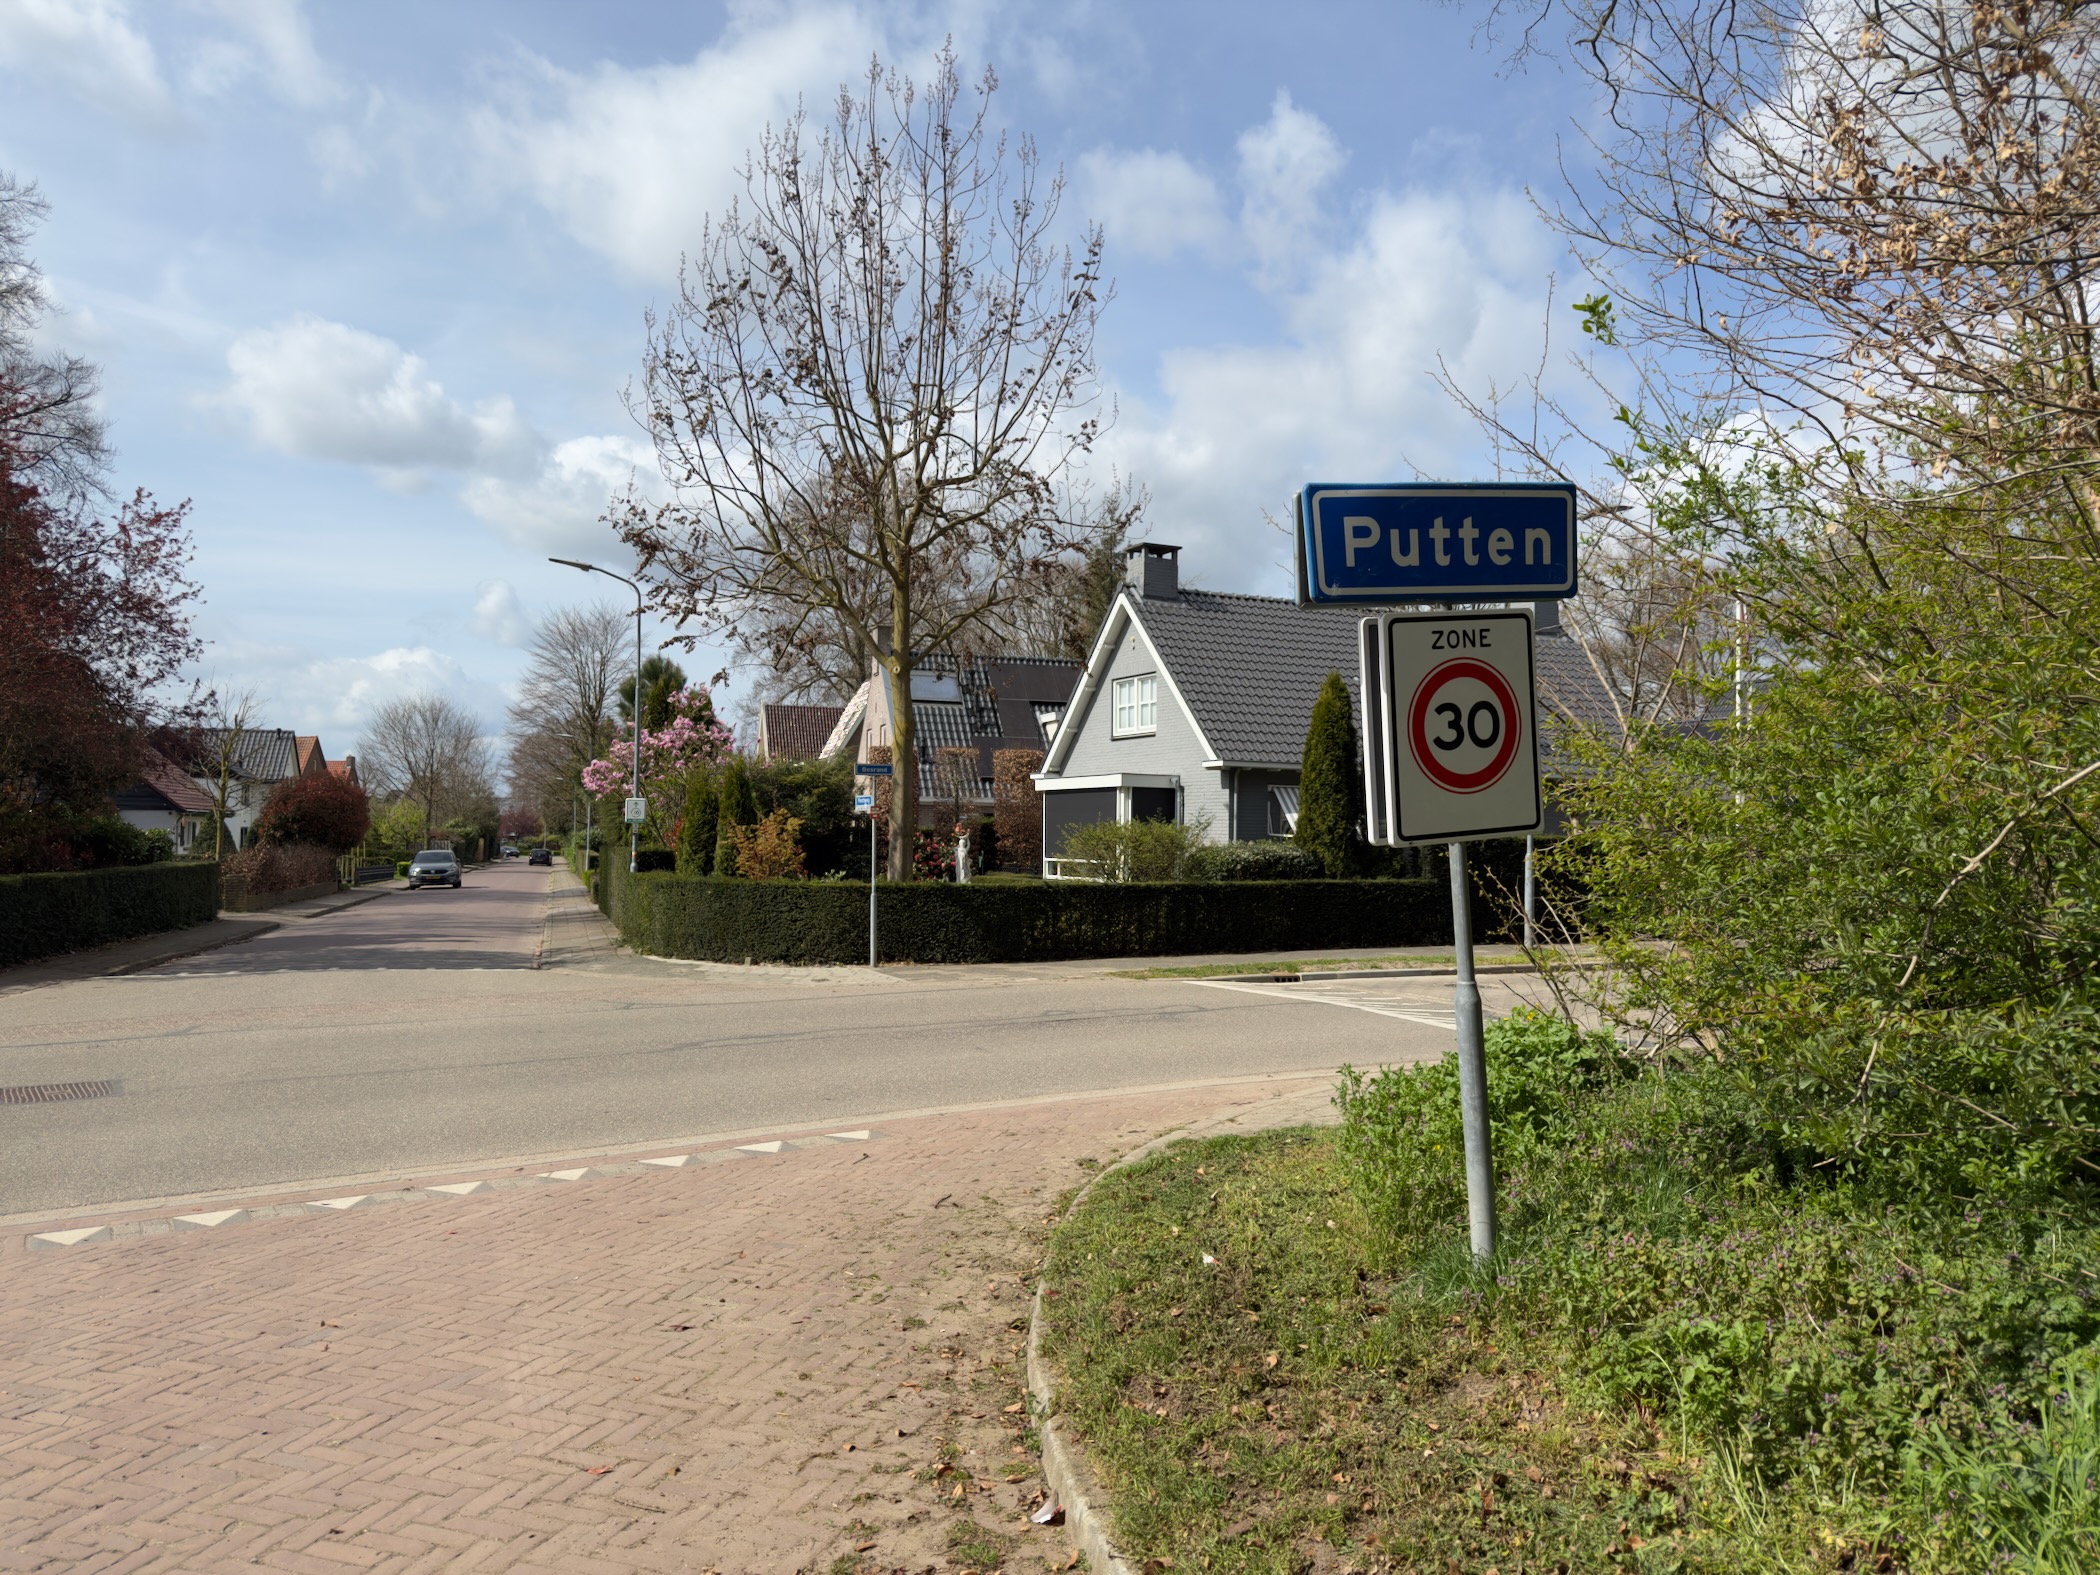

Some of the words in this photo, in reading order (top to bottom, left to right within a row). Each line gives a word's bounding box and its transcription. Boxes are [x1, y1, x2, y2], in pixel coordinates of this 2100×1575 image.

[1343, 515, 1551, 568] Putten
[1431, 628, 1492, 650] ZONE
[1432, 700, 1501, 751] 30
